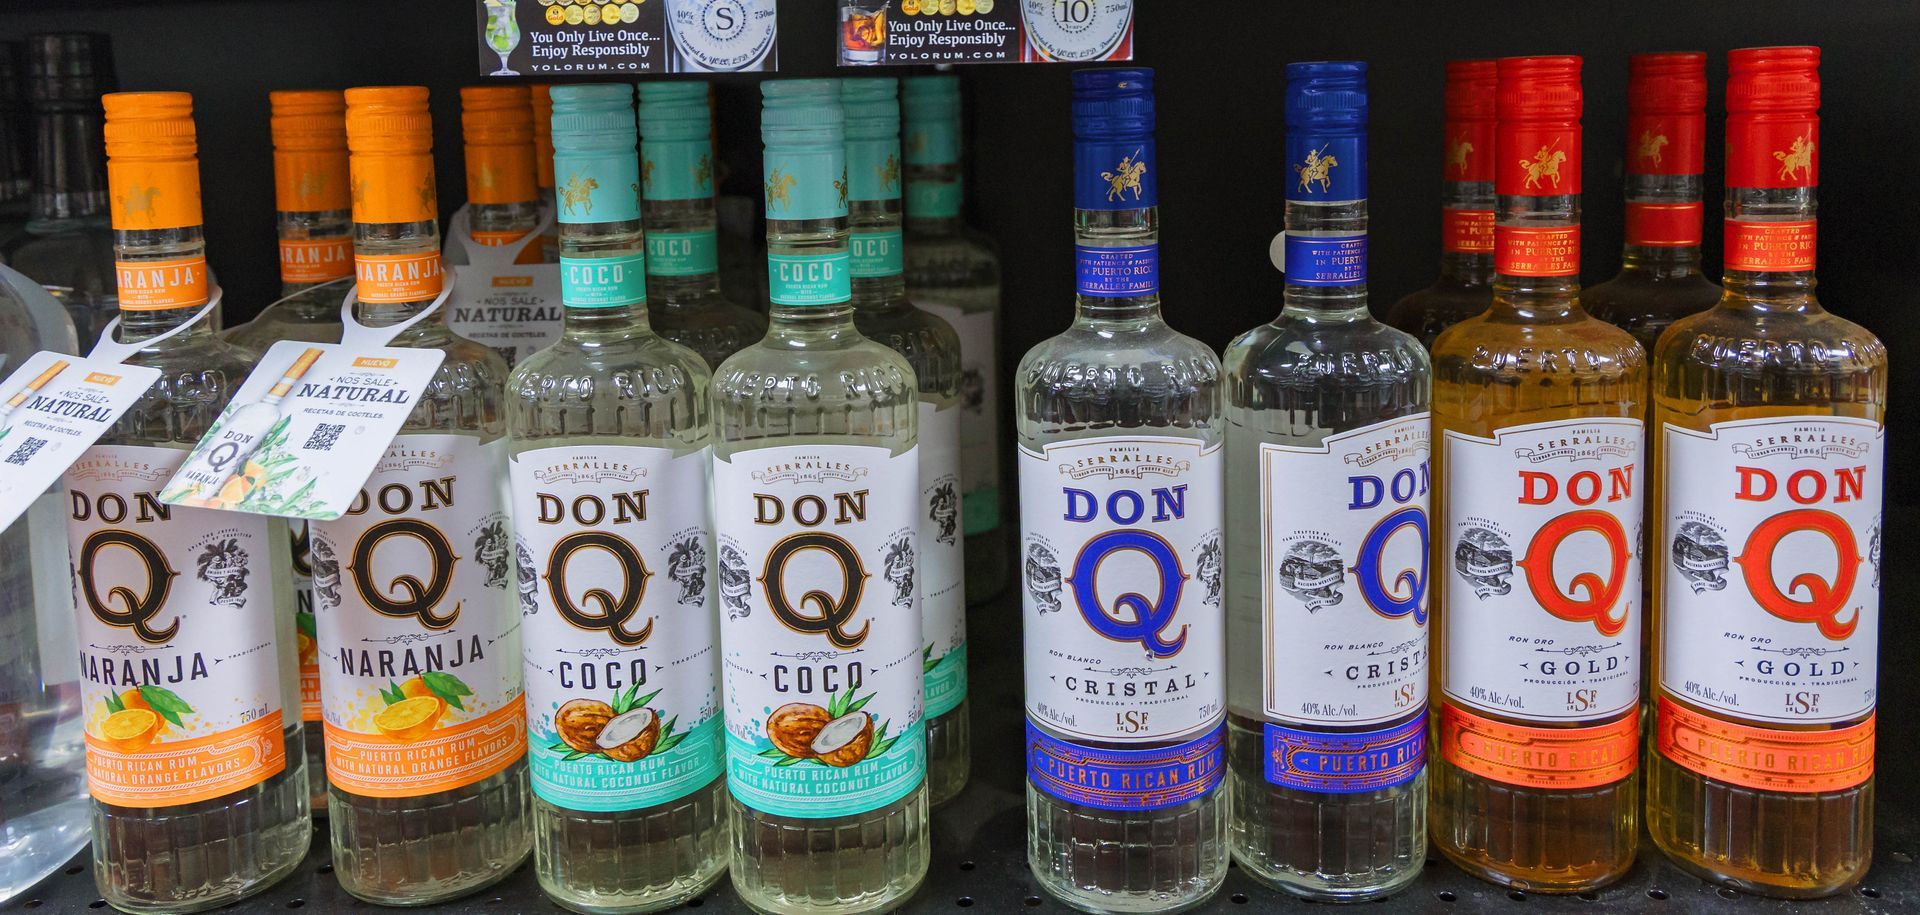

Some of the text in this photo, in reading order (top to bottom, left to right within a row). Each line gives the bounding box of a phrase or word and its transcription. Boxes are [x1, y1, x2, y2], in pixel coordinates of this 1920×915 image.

[716, 7, 734, 30] S
[1059, 0, 1089, 23] 10
[530, 29, 660, 45] You Only Live Once...
[888, 19, 1016, 34] You Only Live Once...
[889, 32, 1006, 48] Enjoy Responsibly
[532, 43, 650, 59] Enjoy Responsibly
[889, 52, 1006, 60] YOLORUM.COM
[531, 62, 651, 71] YOLORUM.COM
[1525, 247, 1566, 256] PUERTO
[1753, 241, 1798, 251] PUERTO
[356, 259, 440, 282] NARANJA
[570, 264, 624, 285] COCO
[779, 262, 833, 282] COCO
[1092, 267, 1132, 276] PUERTO
[484, 296, 538, 306] NOS SALE
[453, 306, 562, 323] NATURAL
[1472, 345, 1602, 372] PUERTO
[1691, 337, 1832, 366] PUERTO
[360, 359, 390, 368] NUEVO
[336, 376, 392, 388] NOS SALE
[63, 390, 107, 404] NOS SALE
[296, 383, 411, 405] NATURAL
[26, 395, 113, 424] NATURAL
[303, 407, 336, 417] RECETAS
[336, 410, 346, 418] DE
[223, 430, 254, 445] DON
[1537, 435, 1625, 451] SERRALLES
[1756, 434, 1856, 447] SERRALLES
[207, 441, 240, 473] Q
[1077, 454, 1173, 468] SERRALLES
[1577, 449, 1596, 457] 1865
[1799, 448, 1820, 456] 1865
[184, 469, 220, 486] NARANJA
[547, 462, 628, 474] SERRALLES
[767, 461, 850, 474] SERRALLES
[1348, 457, 1431, 511] DON
[1518, 463, 1635, 506] DON
[1735, 464, 1867, 505] DON
[344, 475, 457, 516] DON
[1062, 483, 1188, 526] DON
[70, 489, 172, 524] DON
[536, 488, 650, 527] DON
[752, 488, 870, 527] DON
[346, 517, 462, 631] Q
[1347, 504, 1430, 629] Q
[1516, 508, 1633, 637] Q
[1732, 508, 1865, 641] Q
[77, 528, 182, 644] Q
[541, 529, 655, 648] Q
[756, 530, 872, 650] Q
[1064, 528, 1190, 660] Q
[1324, 641, 1384, 651] RON BLANCO
[1508, 635, 1555, 646] RON ORO
[1723, 631, 1772, 645] RON ORO
[340, 634, 484, 677] NARANJA
[1048, 649, 1102, 665] RON BLANCO
[1540, 655, 1619, 676] GOLD
[79, 651, 209, 687] NARANJA
[559, 658, 647, 690] COCO
[773, 661, 863, 694] COCO
[1756, 659, 1845, 677] GOLD
[1065, 674, 1196, 697] CRISTAL
[1523, 677, 1578, 686] PRODUCCIÓN
[1739, 675, 1858, 686] PRODUCCIÓN TRADICIONAL
[1469, 685, 1525, 709] 40% Alc./vol.
[1684, 680, 1740, 707] 40% Alc./vol.
[239, 708, 256, 724] 750
[1036, 700, 1078, 727] 40% Alc./vol.
[1199, 704, 1211, 719] 750
[1300, 702, 1359, 716] 40% Alc./vol.
[336, 736, 508, 776] WITH NATURAL ORANGE FLAVORS
[360, 738, 476, 762] PUERTO RICAN RUM
[1483, 740, 1558, 768] PUERTO
[1697, 737, 1846, 771] PUERTO RICAN
[93, 754, 198, 772] PUERTO RICAN RUM
[93, 757, 241, 785] NATURAL ORANGE FLAVORS
[554, 757, 666, 776] PUERTO RICAN RUM
[764, 761, 879, 782] PUERTO RICAN RUM
[1048, 755, 1215, 789] PUERTO RICAN RUM
[1319, 753, 1389, 772] PUERTO
[553, 771, 597, 788] NATURAL
[601, 770, 657, 789] COCONUT
[661, 758, 699, 779] FLAVOR
[738, 761, 908, 794] WITH NATURAL COCONUT FLAVOR
